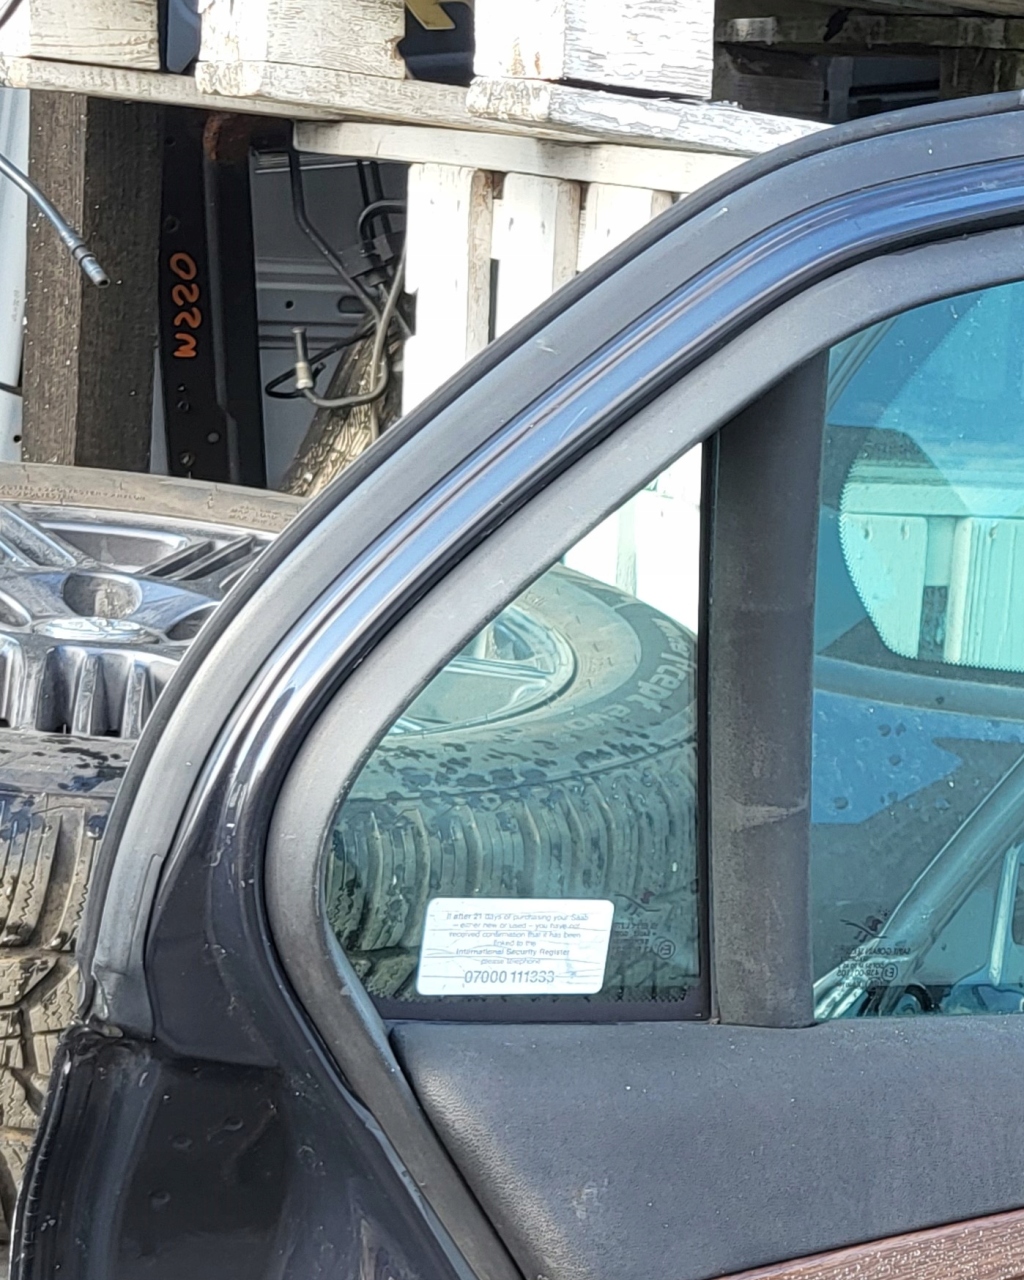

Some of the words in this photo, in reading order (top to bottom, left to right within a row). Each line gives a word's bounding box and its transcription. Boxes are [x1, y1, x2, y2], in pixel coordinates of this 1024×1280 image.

[506, 948, 537, 956] Security
[539, 948, 571, 956] Register
[464, 970, 508, 984] 07000
